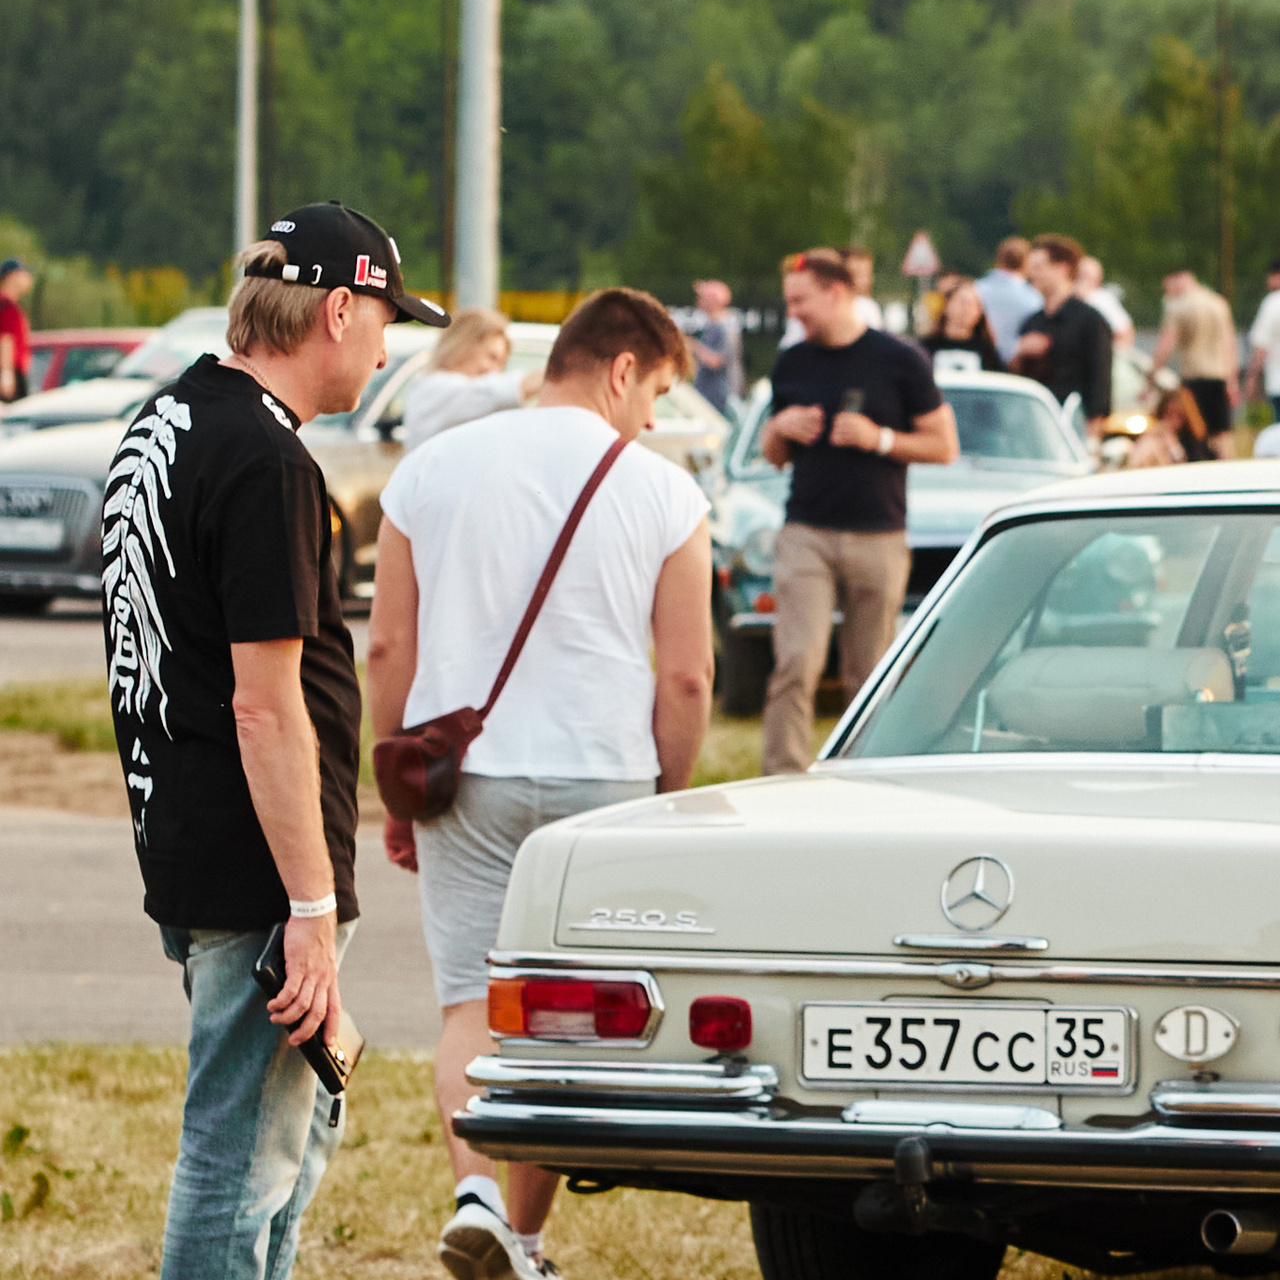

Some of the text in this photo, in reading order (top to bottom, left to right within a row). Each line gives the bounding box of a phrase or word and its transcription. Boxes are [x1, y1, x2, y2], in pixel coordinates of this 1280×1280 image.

[589, 907, 698, 927] 250 S
[1055, 1017, 1105, 1058] 35
[1184, 1009, 1208, 1056] D
[1051, 1060, 1089, 1077] RUS
